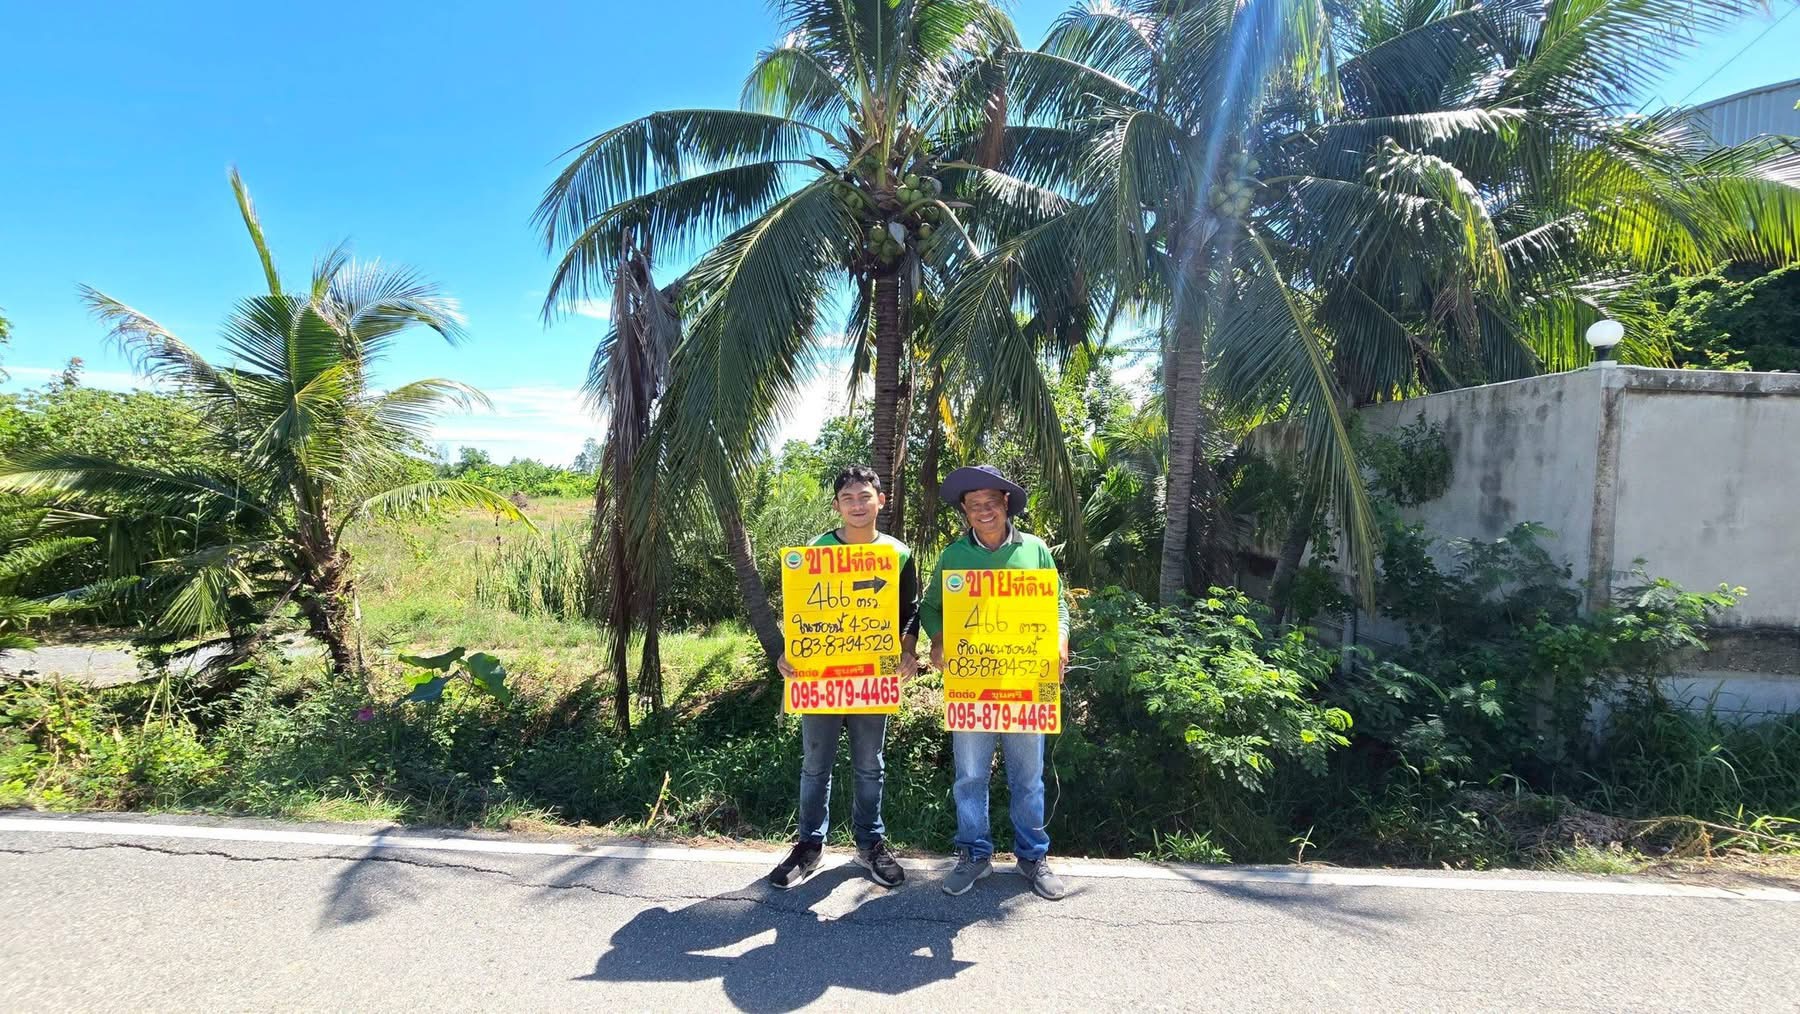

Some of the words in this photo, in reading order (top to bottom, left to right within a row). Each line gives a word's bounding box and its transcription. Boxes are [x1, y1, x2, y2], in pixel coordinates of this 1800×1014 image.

[805, 546, 892, 575] ขายที่ดิน
[806, 581, 851, 610] 466
[965, 570, 1054, 597] ขายที่ดิน
[964, 603, 1009, 634] 466
[791, 634, 894, 658] 083-8794529
[948, 656, 1050, 678] 083-8794529
[791, 676, 900, 709] 095-879-4465
[948, 689, 977, 698] ติดต่อ
[947, 702, 1057, 731] 095-879-4465
